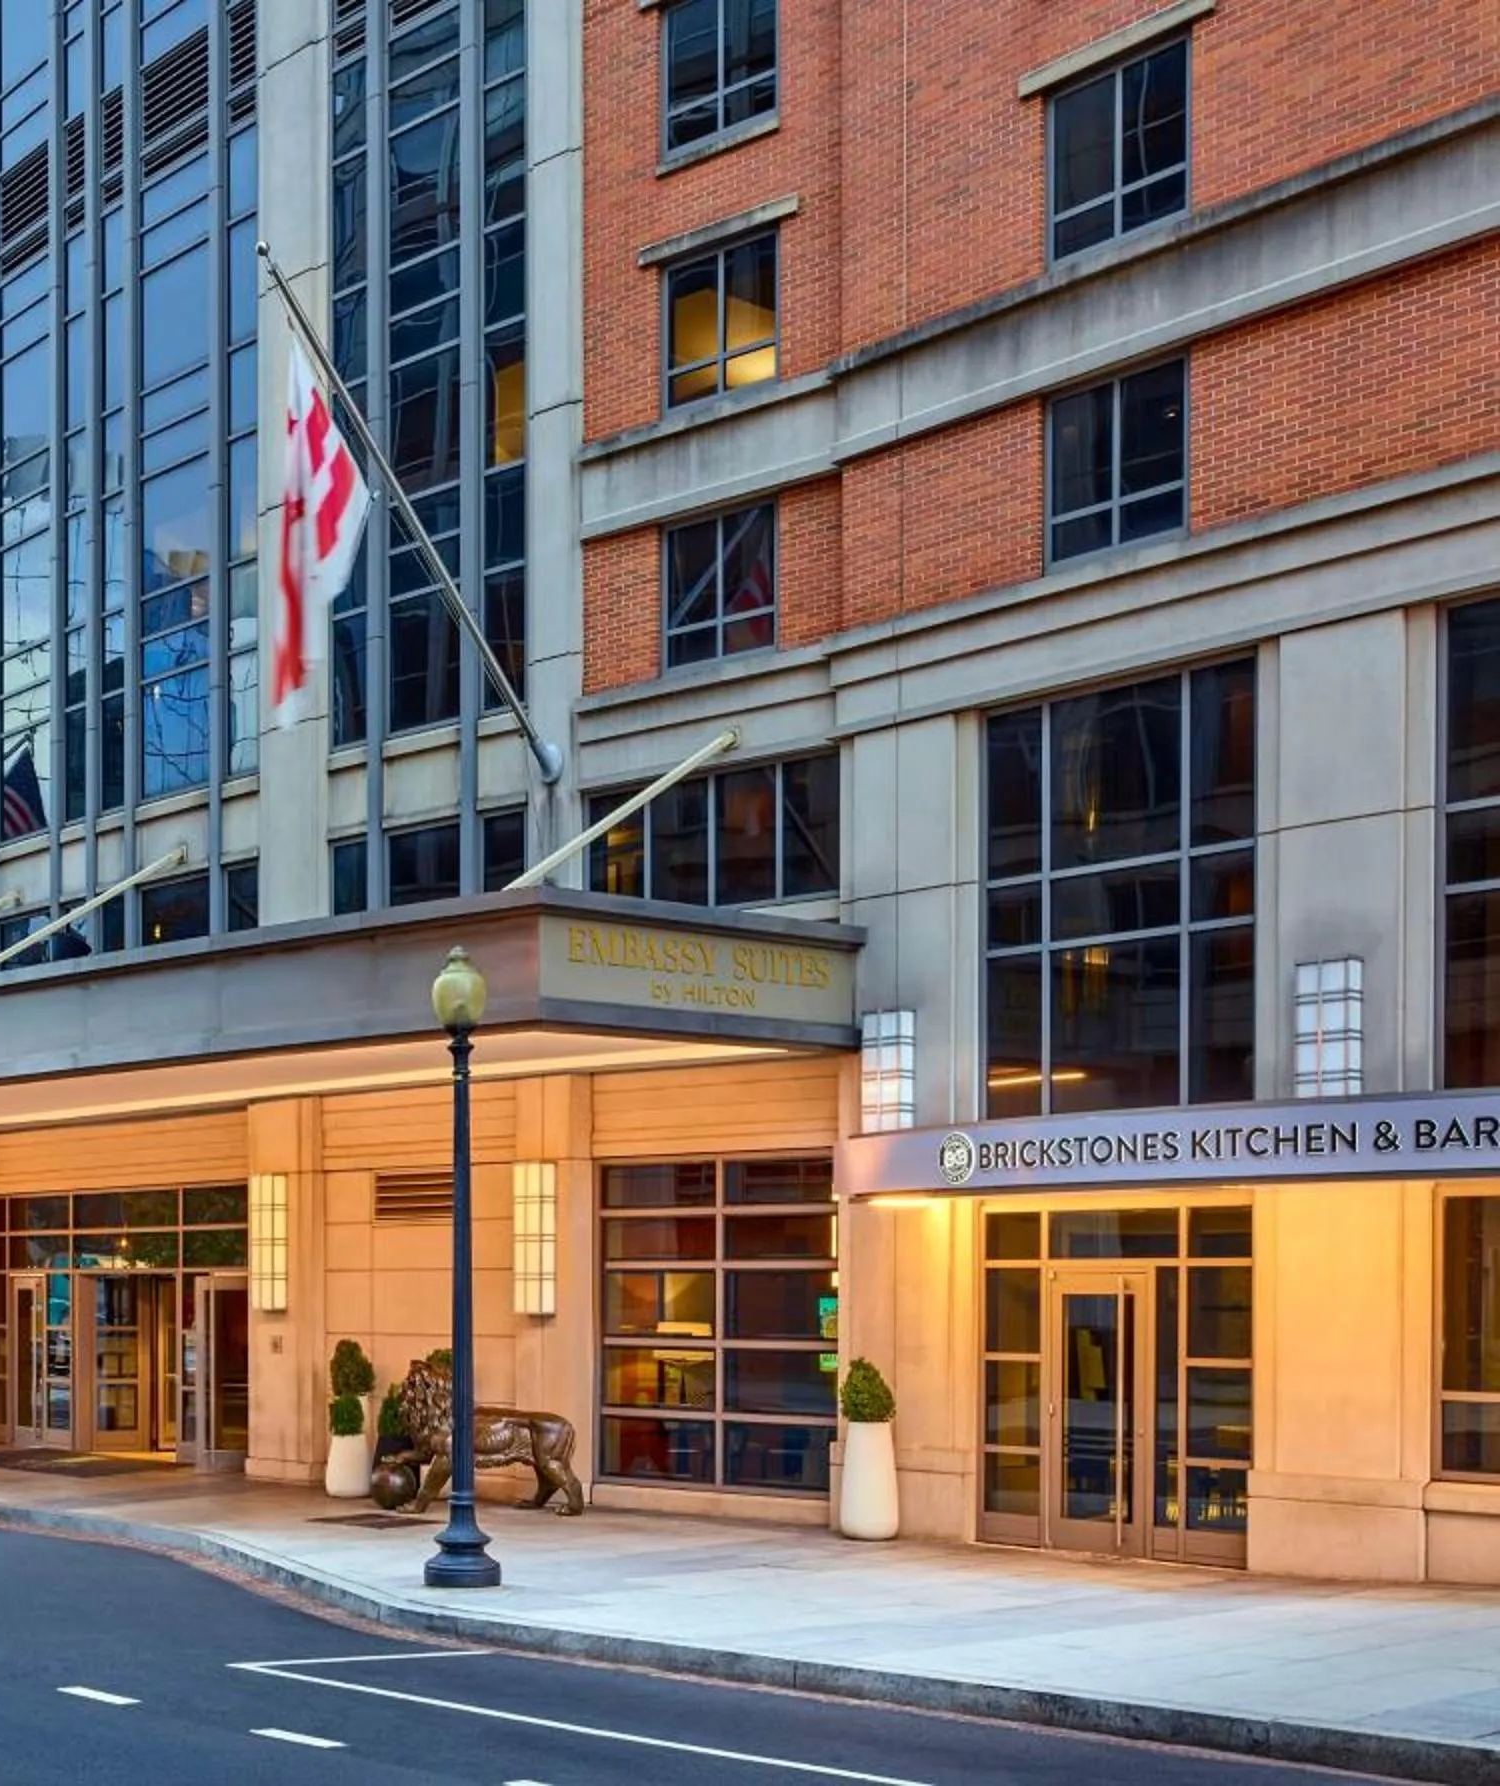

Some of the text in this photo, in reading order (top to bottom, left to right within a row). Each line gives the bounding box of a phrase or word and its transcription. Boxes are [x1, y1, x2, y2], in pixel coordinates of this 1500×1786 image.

[568, 926, 833, 990] EMBASSY SUITES
[682, 983, 757, 1009] HILTON
[978, 1131, 1180, 1170] BRICKSTONES
[1191, 1122, 1359, 1160] KITCHEN
[1373, 1119, 1402, 1152] &
[1415, 1115, 1500, 1150] BAR
